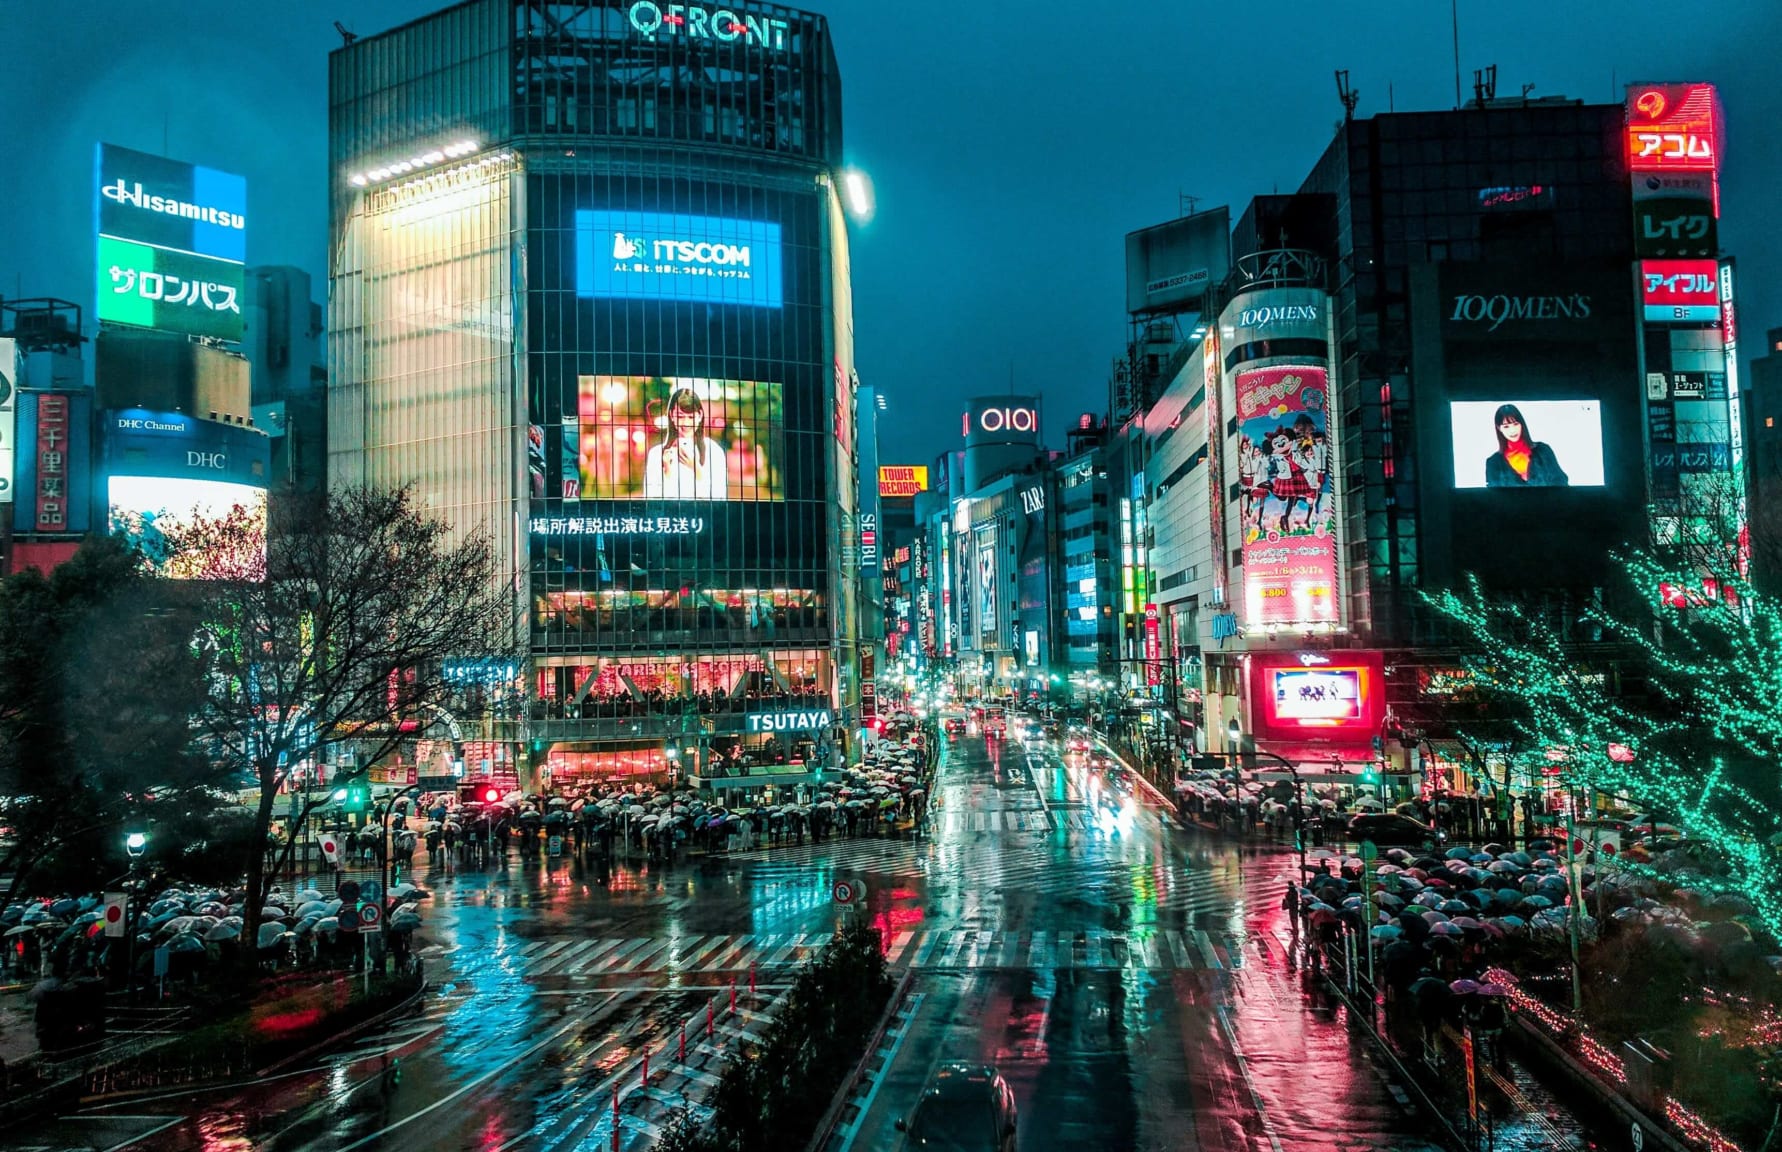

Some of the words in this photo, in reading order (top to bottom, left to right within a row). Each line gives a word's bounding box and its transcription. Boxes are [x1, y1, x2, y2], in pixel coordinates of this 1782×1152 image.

[629, 0, 788, 50] QFRONT
[1637, 134, 1711, 157] アコム
[102, 178, 245, 230] Hisamitsu
[1642, 215, 1710, 241] レイク
[108, 264, 241, 314] サロンパス
[1644, 272, 1716, 294] アイフル
[1673, 307, 1691, 320] 8F
[118, 418, 143, 429] DHC
[144, 419, 185, 432] Channel
[187, 451, 226, 469] DHC
[882, 468, 915, 481] TOWER
[880, 481, 921, 494] RECORDS
[529, 517, 704, 535] 場所解説出演は見送り
[914, 537, 922, 579] KARAOKE
[749, 711, 830, 732] TSUTAYA
